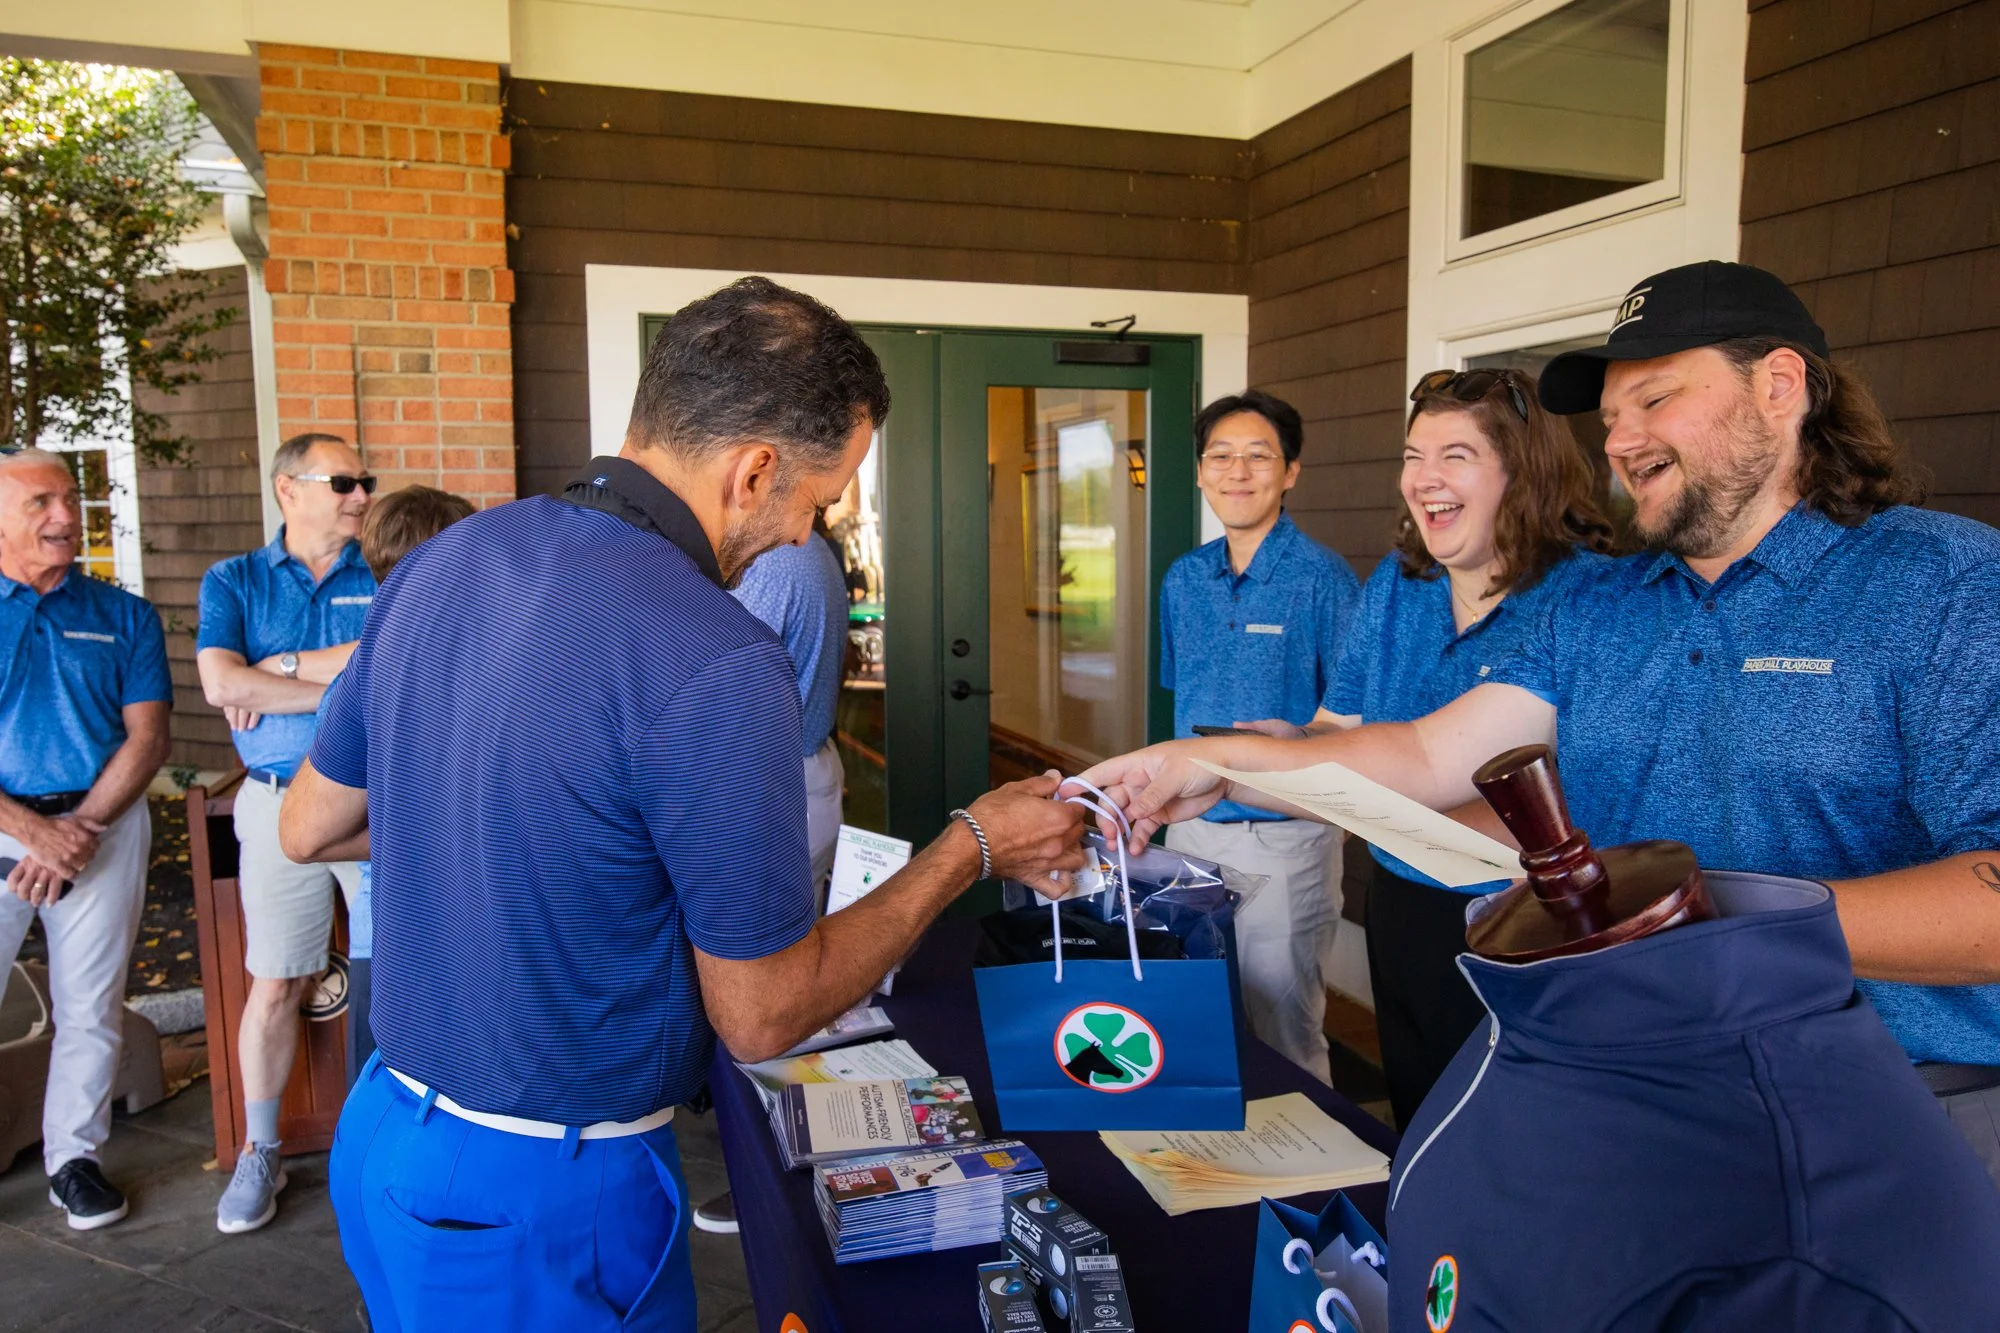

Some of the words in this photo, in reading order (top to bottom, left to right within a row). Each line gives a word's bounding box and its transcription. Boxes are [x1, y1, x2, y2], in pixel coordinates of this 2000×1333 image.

[1743, 661, 1764, 670] PAPER
[1763, 659, 1780, 669] MILL
[1781, 661, 1833, 671] PLAYHOUSE
[859, 1086, 879, 1140] PERFORMANCES
[870, 1083, 894, 1141] AUTISM-FRIENDLY
[903, 1107, 918, 1139] PLAYHOUSE
[1108, 1293, 1116, 1302] 3
